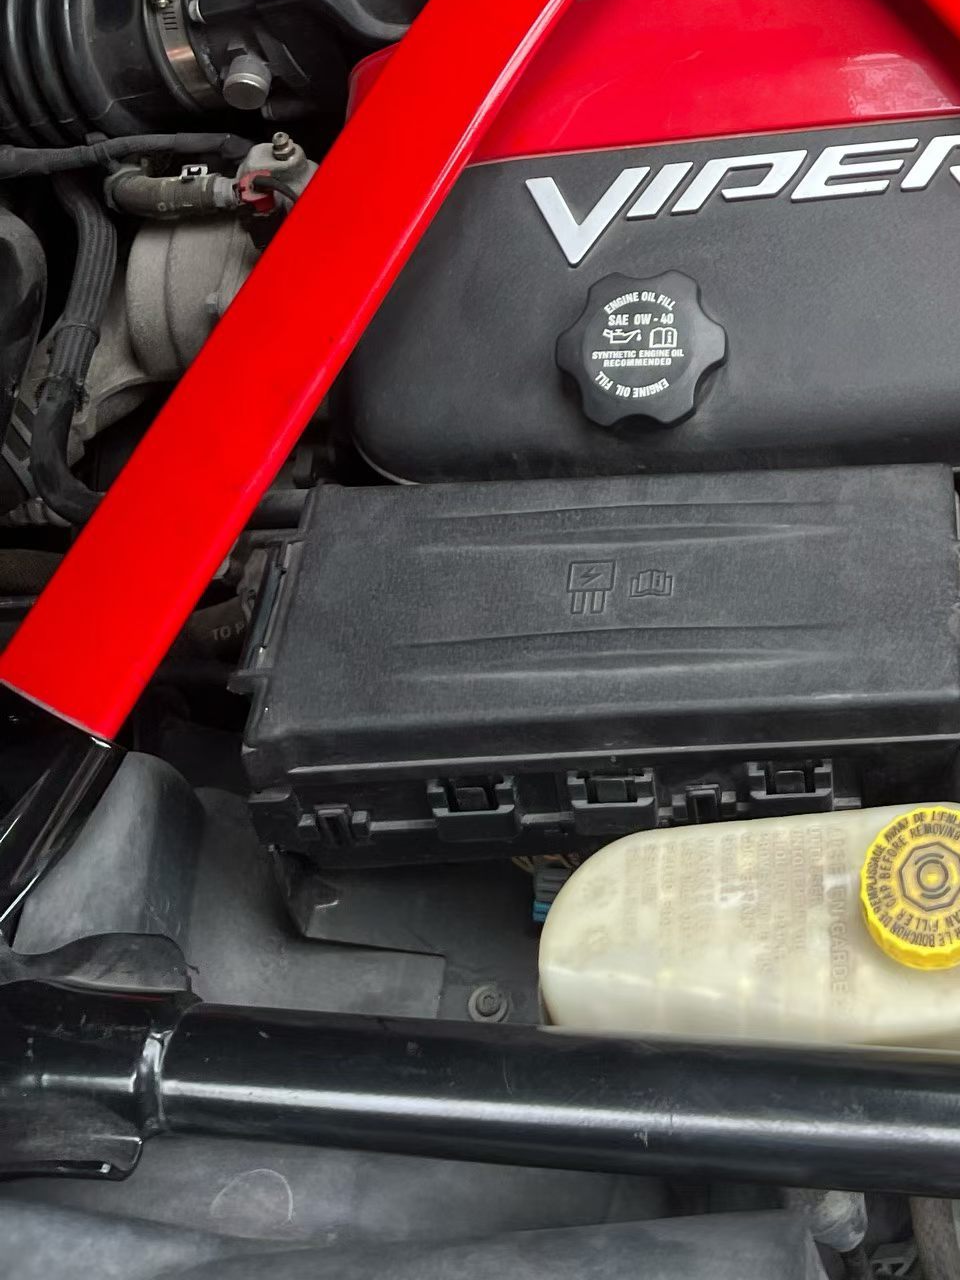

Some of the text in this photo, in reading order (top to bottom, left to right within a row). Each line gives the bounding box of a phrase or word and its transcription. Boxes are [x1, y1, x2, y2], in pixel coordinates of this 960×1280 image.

[604, 291, 675, 314] ENGINE OIL FILL
[608, 314, 628, 325] SAE
[592, 351, 636, 360] SYNTHETIC
[639, 350, 669, 358] ENGINE
[603, 358, 671, 367] RECOMMENDED
[595, 371, 669, 398] ENGINE OIL FILL
[212, 625, 231, 640] TO
[913, 812, 926, 822] DE
[878, 835, 908, 879] BEFORE
[880, 885, 896, 907] CAP
[880, 912, 893, 928] DE
[897, 909, 939, 932] FILLER
[890, 923, 935, 947] BOUCHON
[939, 933, 953, 946] LE
